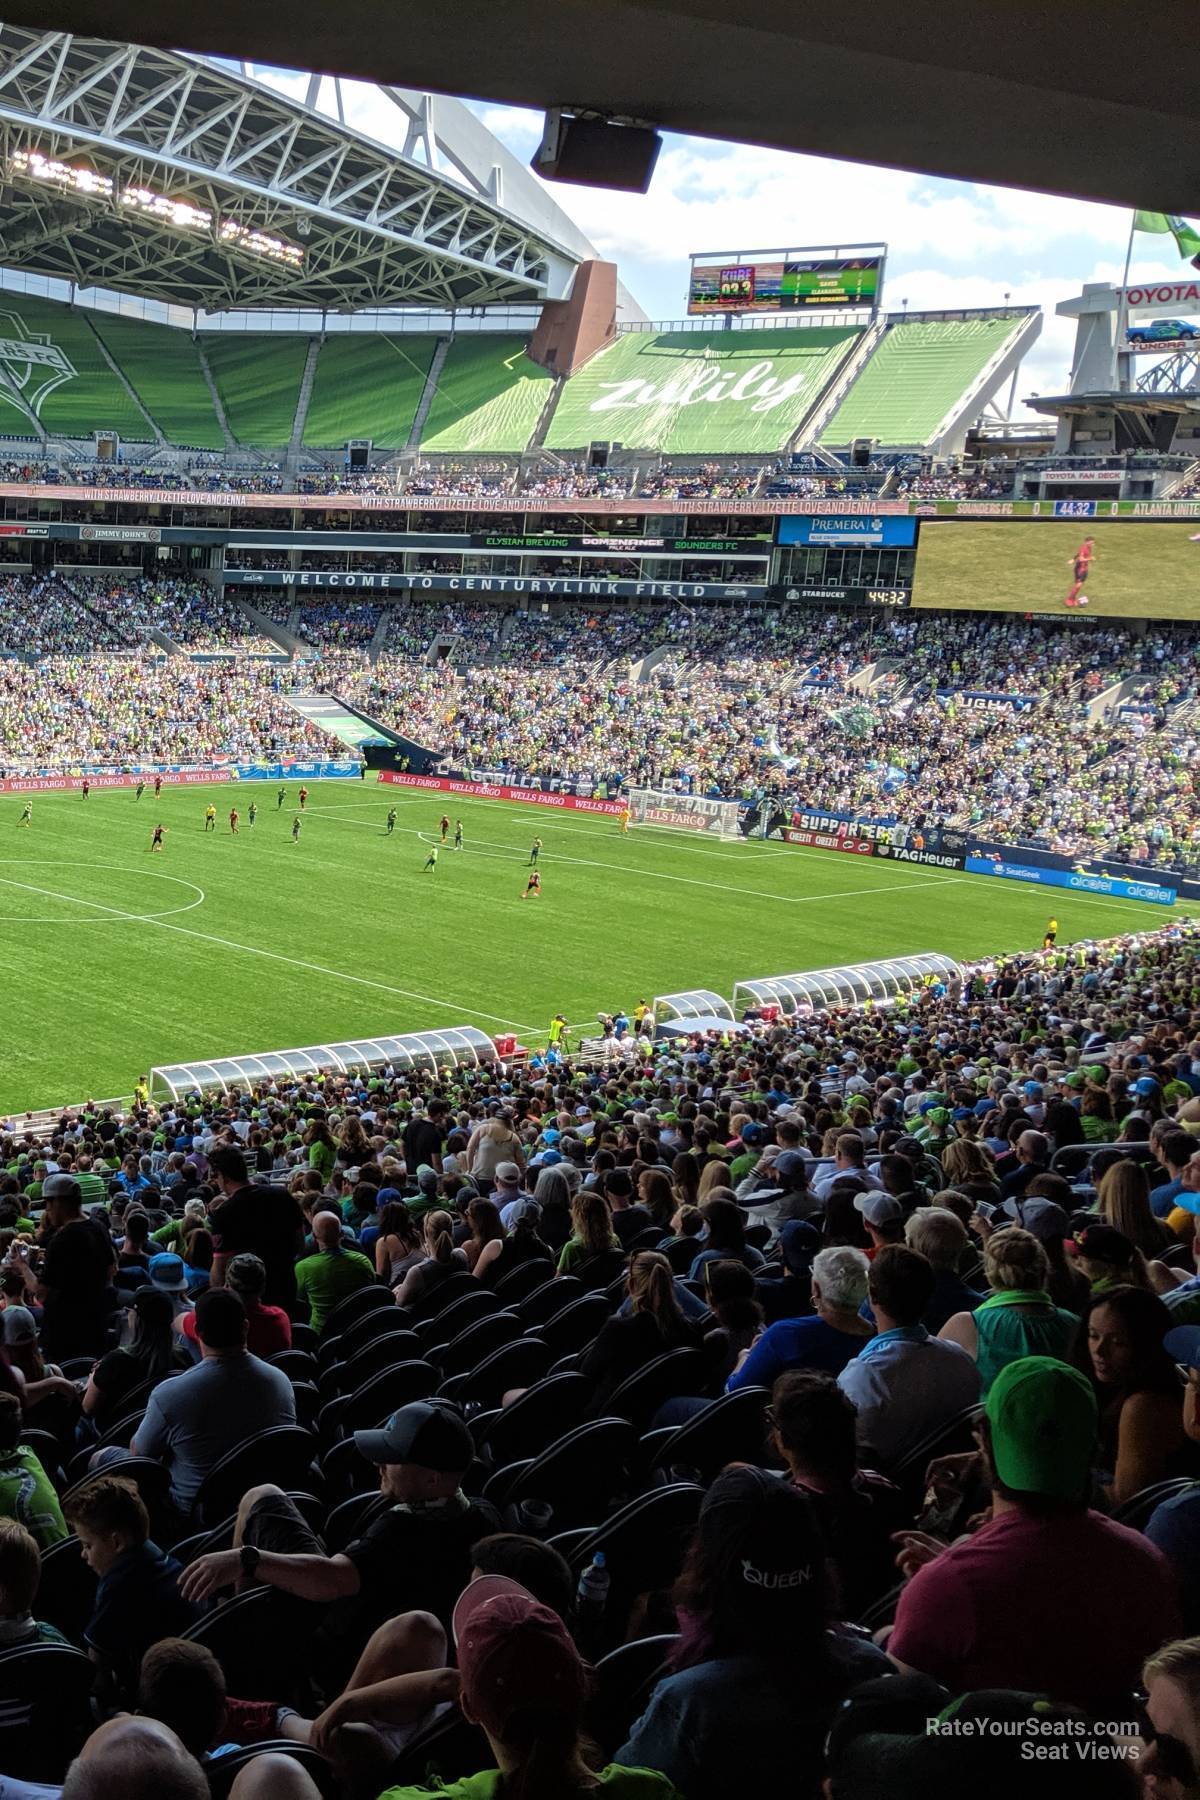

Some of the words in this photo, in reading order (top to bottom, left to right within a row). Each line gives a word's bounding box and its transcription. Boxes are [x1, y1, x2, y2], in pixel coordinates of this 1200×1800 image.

[1116, 285, 1200, 306] TOYOTA
[1131, 341, 1186, 351] TUNDRA
[36, 352, 61, 365] FC
[589, 361, 807, 412] zulily
[1079, 472, 1095, 480] FAN
[84, 489, 103, 500] WITH
[223, 495, 246, 505] JENNA
[361, 498, 382, 508] WITH
[479, 500, 500, 511] LOVE
[502, 501, 520, 511] AND
[521, 501, 549, 511] JENNA
[672, 502, 694, 513] WITH
[761, 502, 798, 513] LIZETTE
[800, 502, 823, 513] LOVE
[824, 502, 844, 513] AND
[846, 502, 877, 513] JENNA
[956, 503, 1001, 514] SOUNDERS
[1002, 503, 1013, 514] FC
[1032, 503, 1040, 514] 0
[1060, 502, 1090, 515] 44:32
[1111, 503, 1118, 515] 0
[1134, 503, 1172, 515] ATLANTA
[811, 518, 865, 531] PREMERA
[94, 530, 121, 538] JIMMY
[122, 530, 147, 538] JOHN'S
[486, 538, 524, 546] ELYSIAN
[526, 539, 568, 547] BREWING
[675, 541, 723, 550] SOUNDERS
[725, 542, 738, 550] FC
[282, 573, 390, 587] WELCOME
[407, 577, 433, 588] TO
[449, 578, 618, 594] CENTURYLINK
[636, 585, 705, 597] FIELD
[802, 590, 846, 598] STARBUCKS
[868, 591, 906, 604] 44:32
[99, 777, 125, 786] FARGO
[186, 773, 210, 782] WELLS
[392, 775, 416, 786] WELLS
[417, 779, 441, 789] FARGO
[11, 781, 38, 790] WELLS
[40, 780, 65, 788] FARGO
[449, 783, 474, 793] WELLS
[475, 786, 501, 797] FARGO
[510, 790, 536, 802] WELLS
[537, 794, 565, 806] FARGO
[575, 800, 602, 811] WELLS
[671, 813, 705, 827] FARGO
[1005, 867, 1041, 880] SeatGeek
